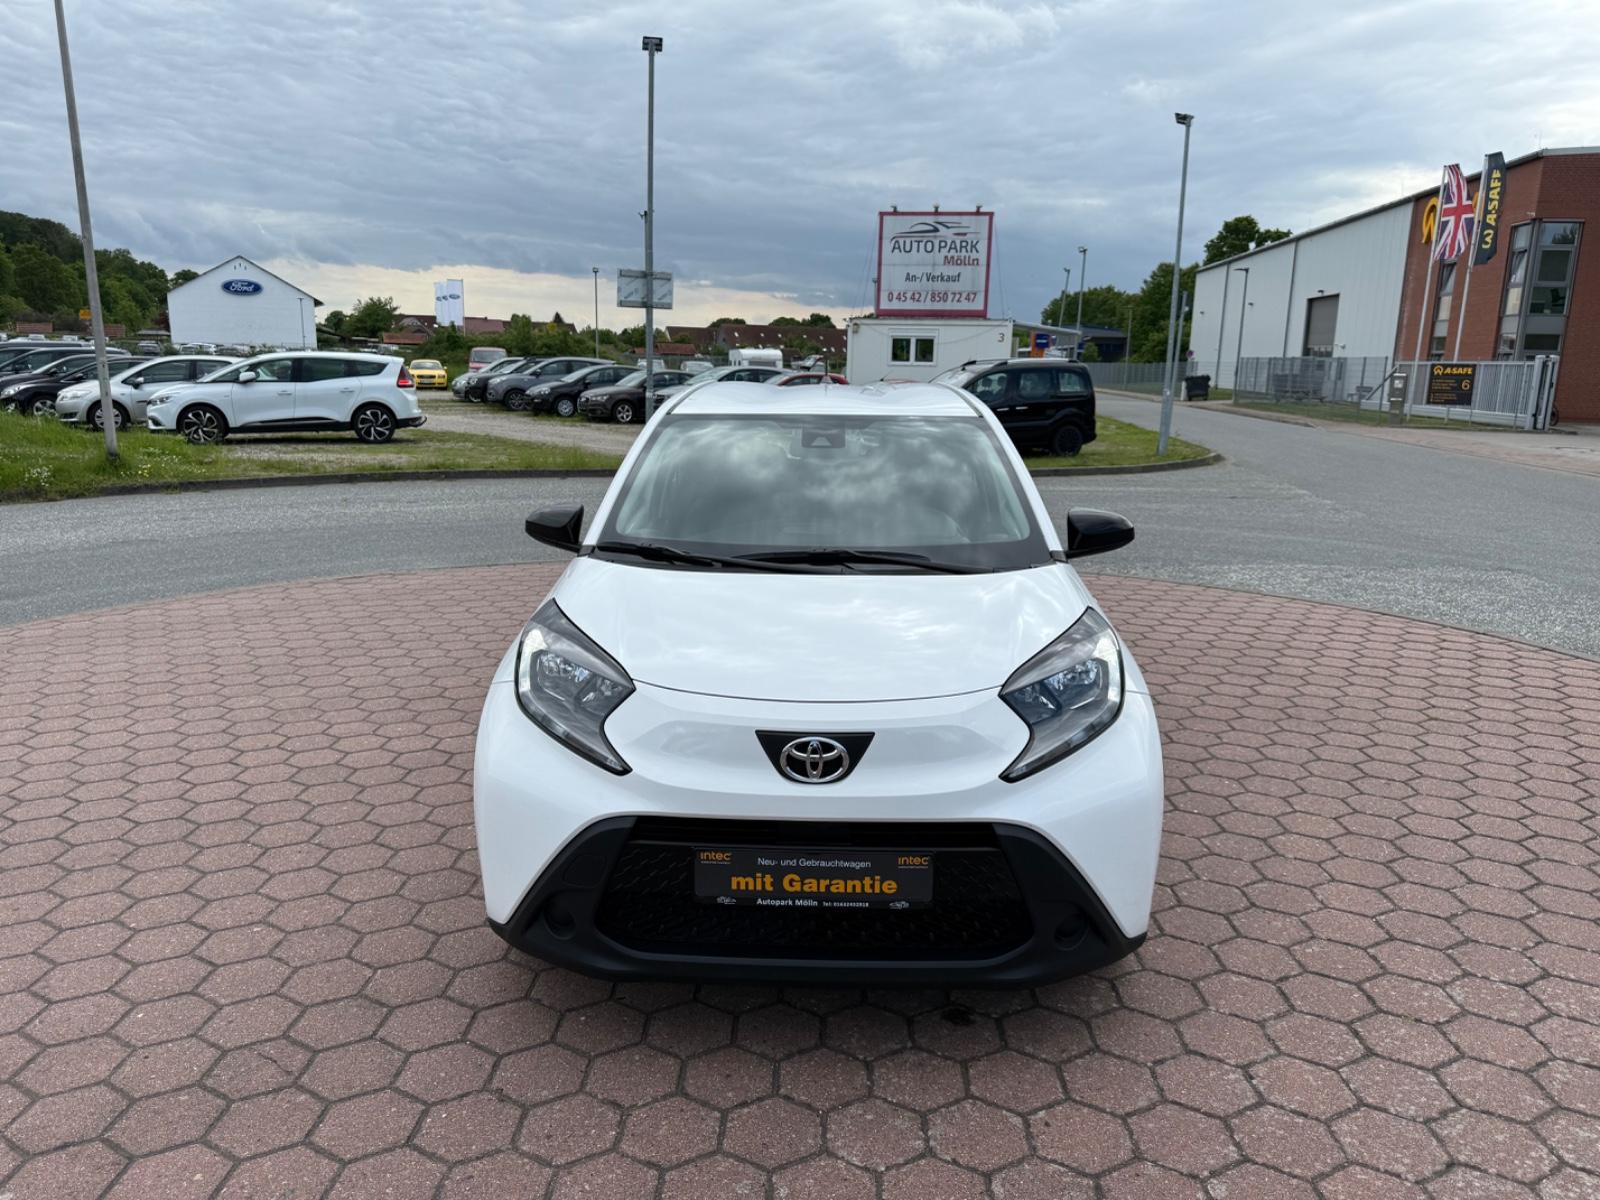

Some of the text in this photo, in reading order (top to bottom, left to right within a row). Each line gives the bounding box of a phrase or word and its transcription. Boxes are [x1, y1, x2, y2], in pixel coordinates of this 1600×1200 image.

[891, 240, 980, 254] AUTO PARK
[943, 255, 980, 267] Mölln
[904, 271, 962, 283] An-/ Verkauf
[231, 282, 255, 291] Ford
[887, 292, 894, 302] 0
[895, 292, 908, 303] 45
[909, 292, 922, 303] 42
[930, 292, 949, 303] 850
[950, 292, 962, 303] 72
[964, 292, 977, 303] 47
[997, 332, 1005, 343] 3
[1461, 379, 1471, 391] 6
[700, 851, 731, 861] intec
[898, 856, 929, 865] intec
[757, 857, 872, 869] Neu- und Gebrauchtwagen
[731, 873, 898, 894] mit Garantie
[756, 898, 793, 907] Autopark
[794, 898, 818, 906] Mölln
